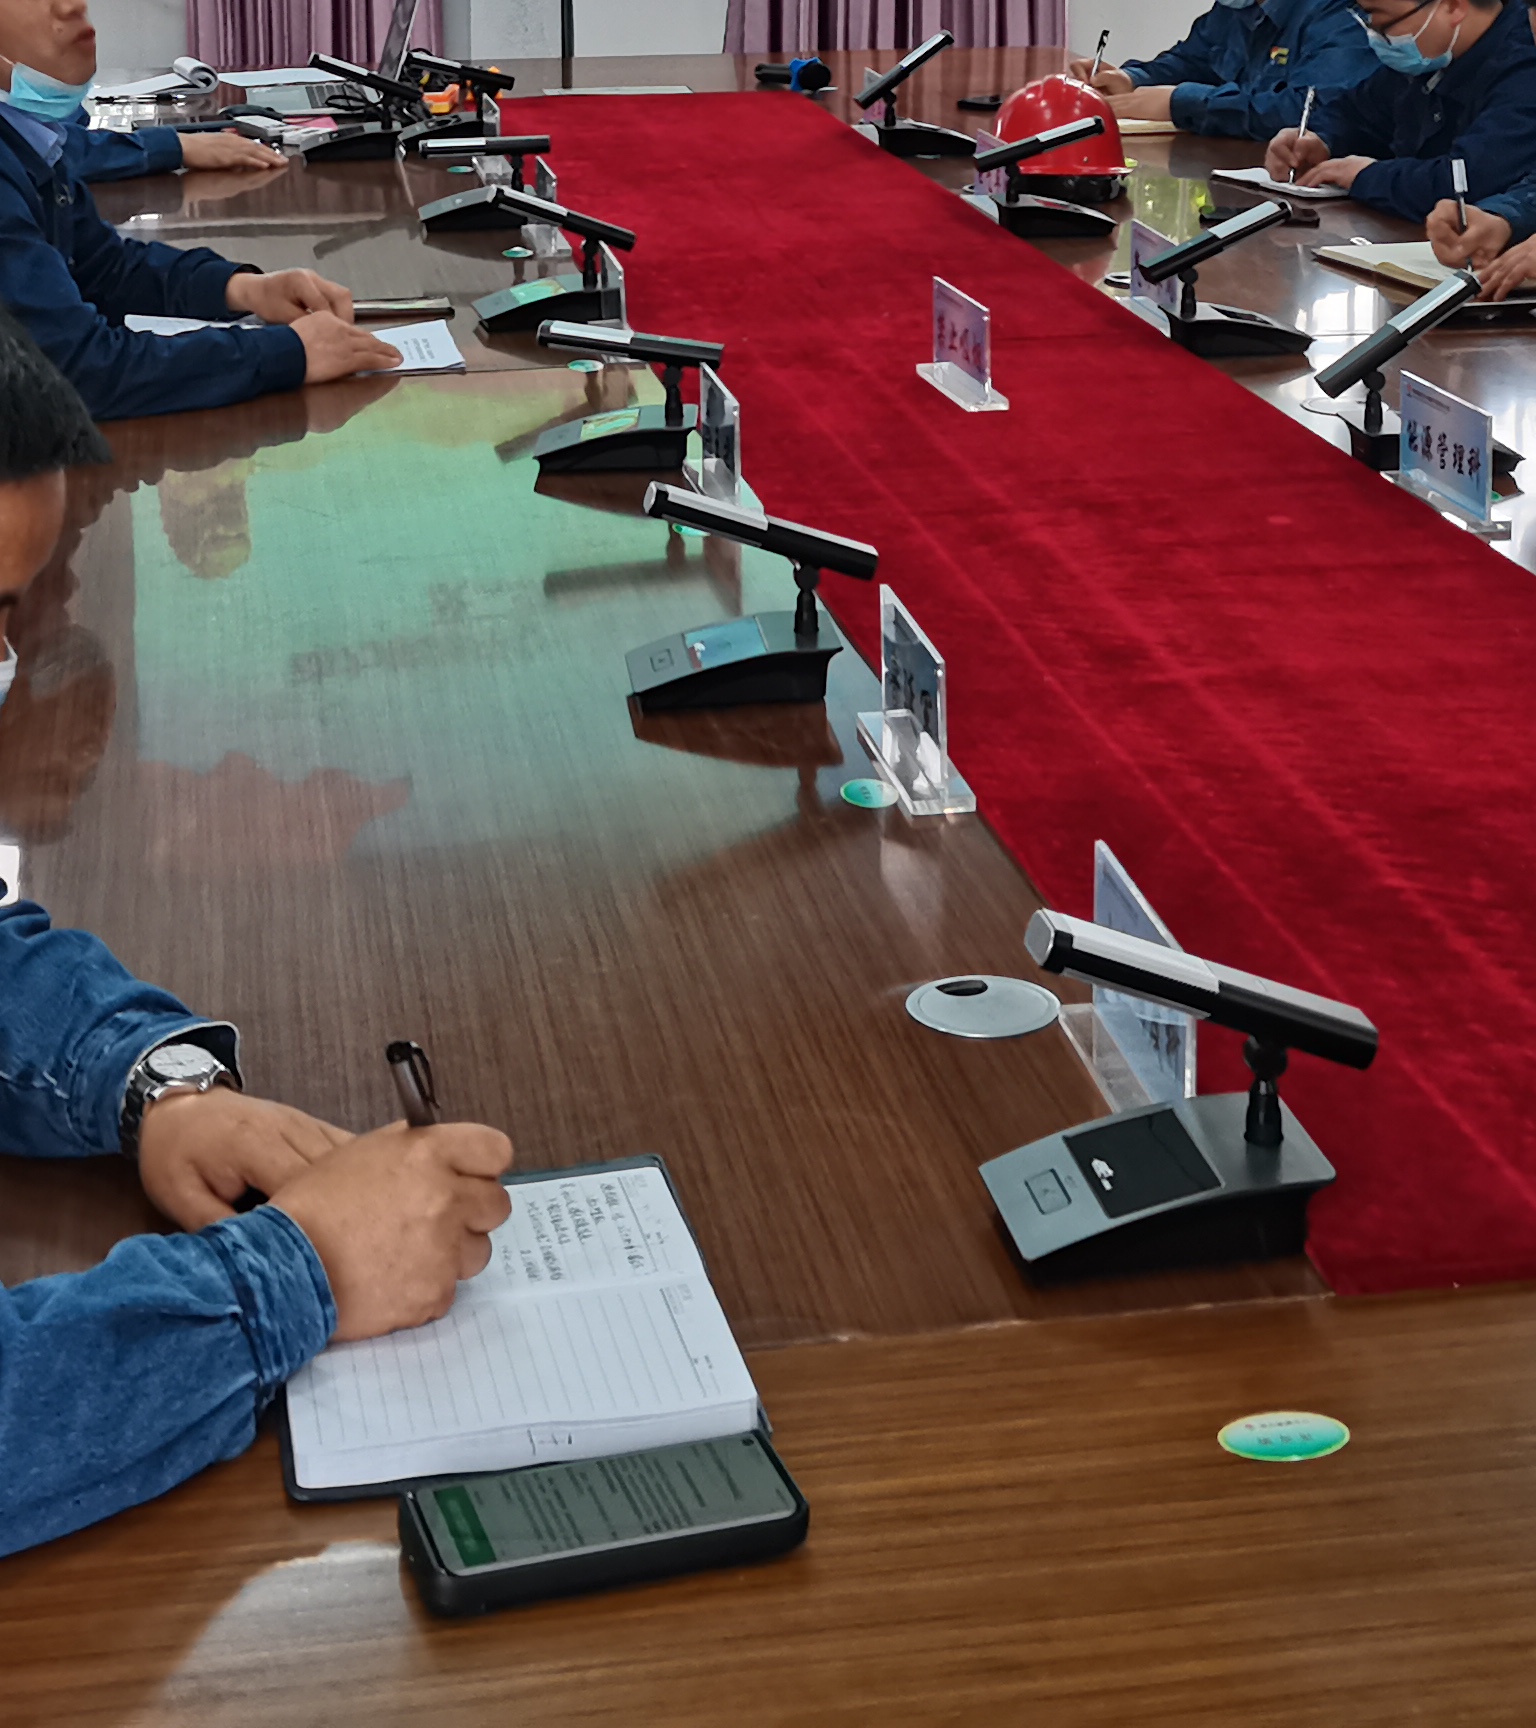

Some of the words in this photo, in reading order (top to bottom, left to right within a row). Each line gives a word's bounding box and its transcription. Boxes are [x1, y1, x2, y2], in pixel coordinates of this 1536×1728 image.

[1407, 419, 1482, 491] 能源管理科
